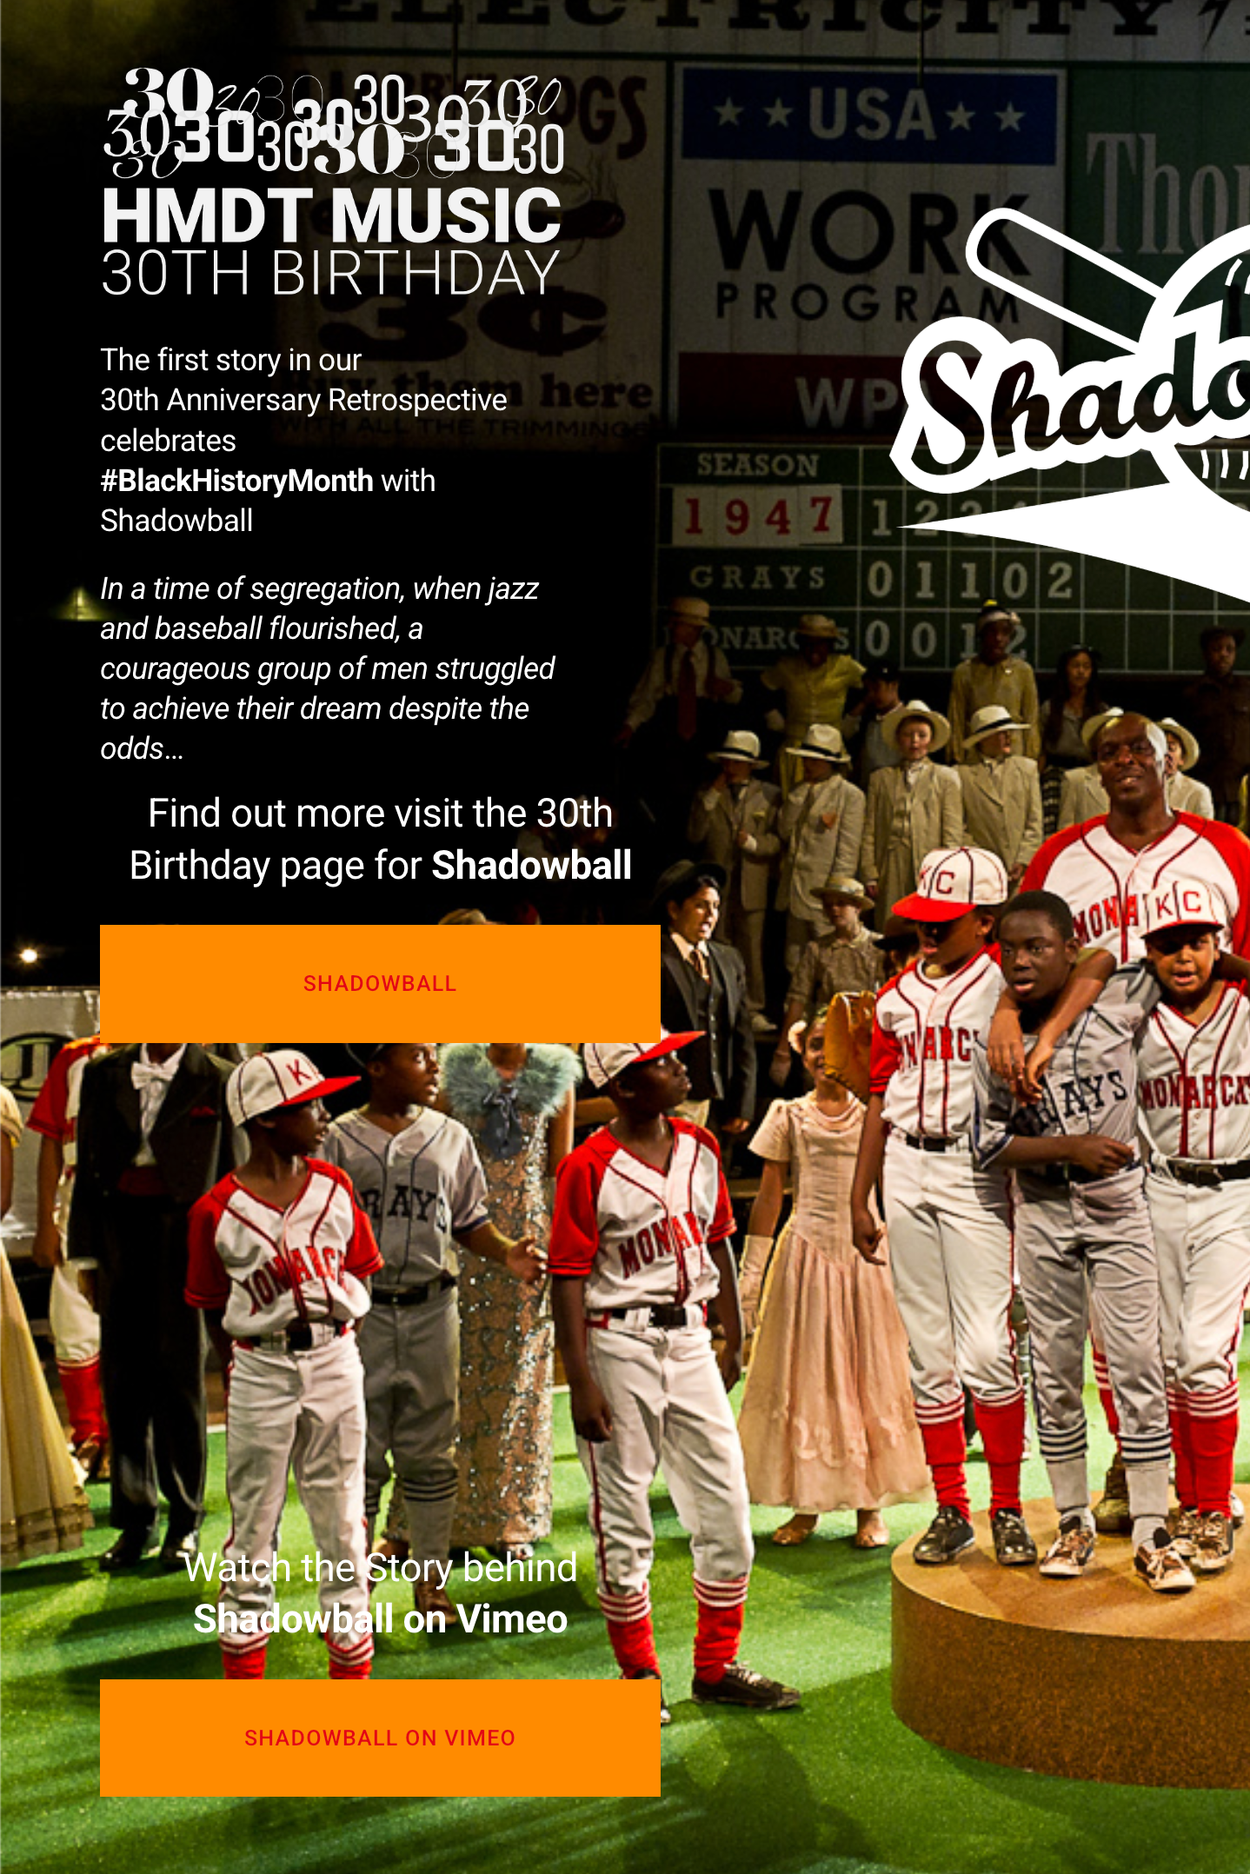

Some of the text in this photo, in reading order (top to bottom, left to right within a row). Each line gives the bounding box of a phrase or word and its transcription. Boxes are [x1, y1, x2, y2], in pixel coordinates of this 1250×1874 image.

[808, 85, 939, 142] USA
[709, 189, 1031, 276] WORK
[716, 282, 1019, 323] PROGRAM
[539, 372, 654, 408] here
[280, 416, 347, 434] WITH
[357, 416, 411, 435] ALL
[417, 418, 475, 436] THE
[697, 452, 821, 478] SEASON
[686, 496, 832, 535] 1947
[872, 499, 892, 537] 1
[688, 563, 826, 591] GRAYS
[867, 560, 893, 599] 0
[916, 560, 936, 598] 1
[961, 561, 981, 599] 1
[1002, 561, 1029, 599] 0
[1047, 561, 1074, 599] 2
[864, 619, 891, 657] 0
[911, 621, 938, 659] 0
[1155, 891, 1202, 920] KC
[286, 1058, 313, 1087] K
